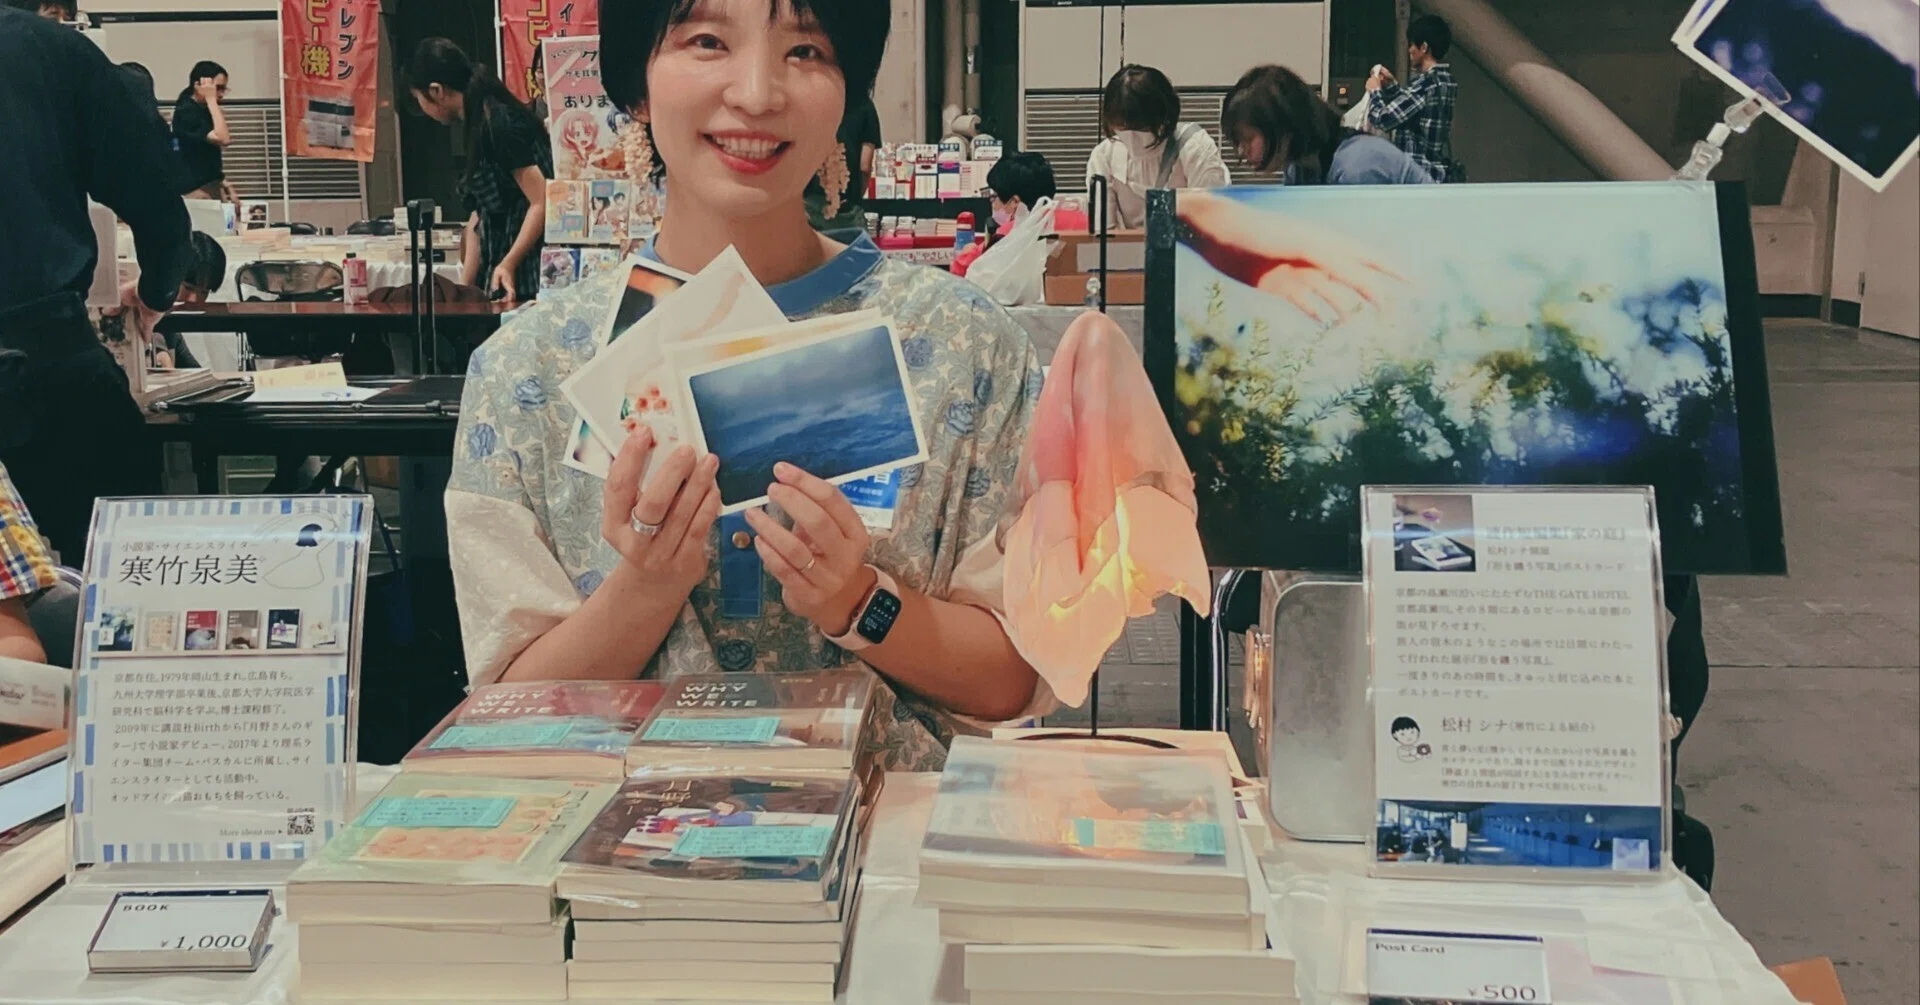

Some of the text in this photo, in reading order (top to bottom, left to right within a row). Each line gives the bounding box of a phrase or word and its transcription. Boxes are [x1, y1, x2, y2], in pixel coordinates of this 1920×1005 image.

[337, 0, 357, 79] レブン
[120, 553, 259, 587] 寒竹泉美
[686, 685, 747, 693] WHY
[485, 691, 545, 700] WHY
[471, 706, 553, 714] WRITE
[123, 903, 170, 912] BOOK
[1375, 942, 1446, 954] Post Card
